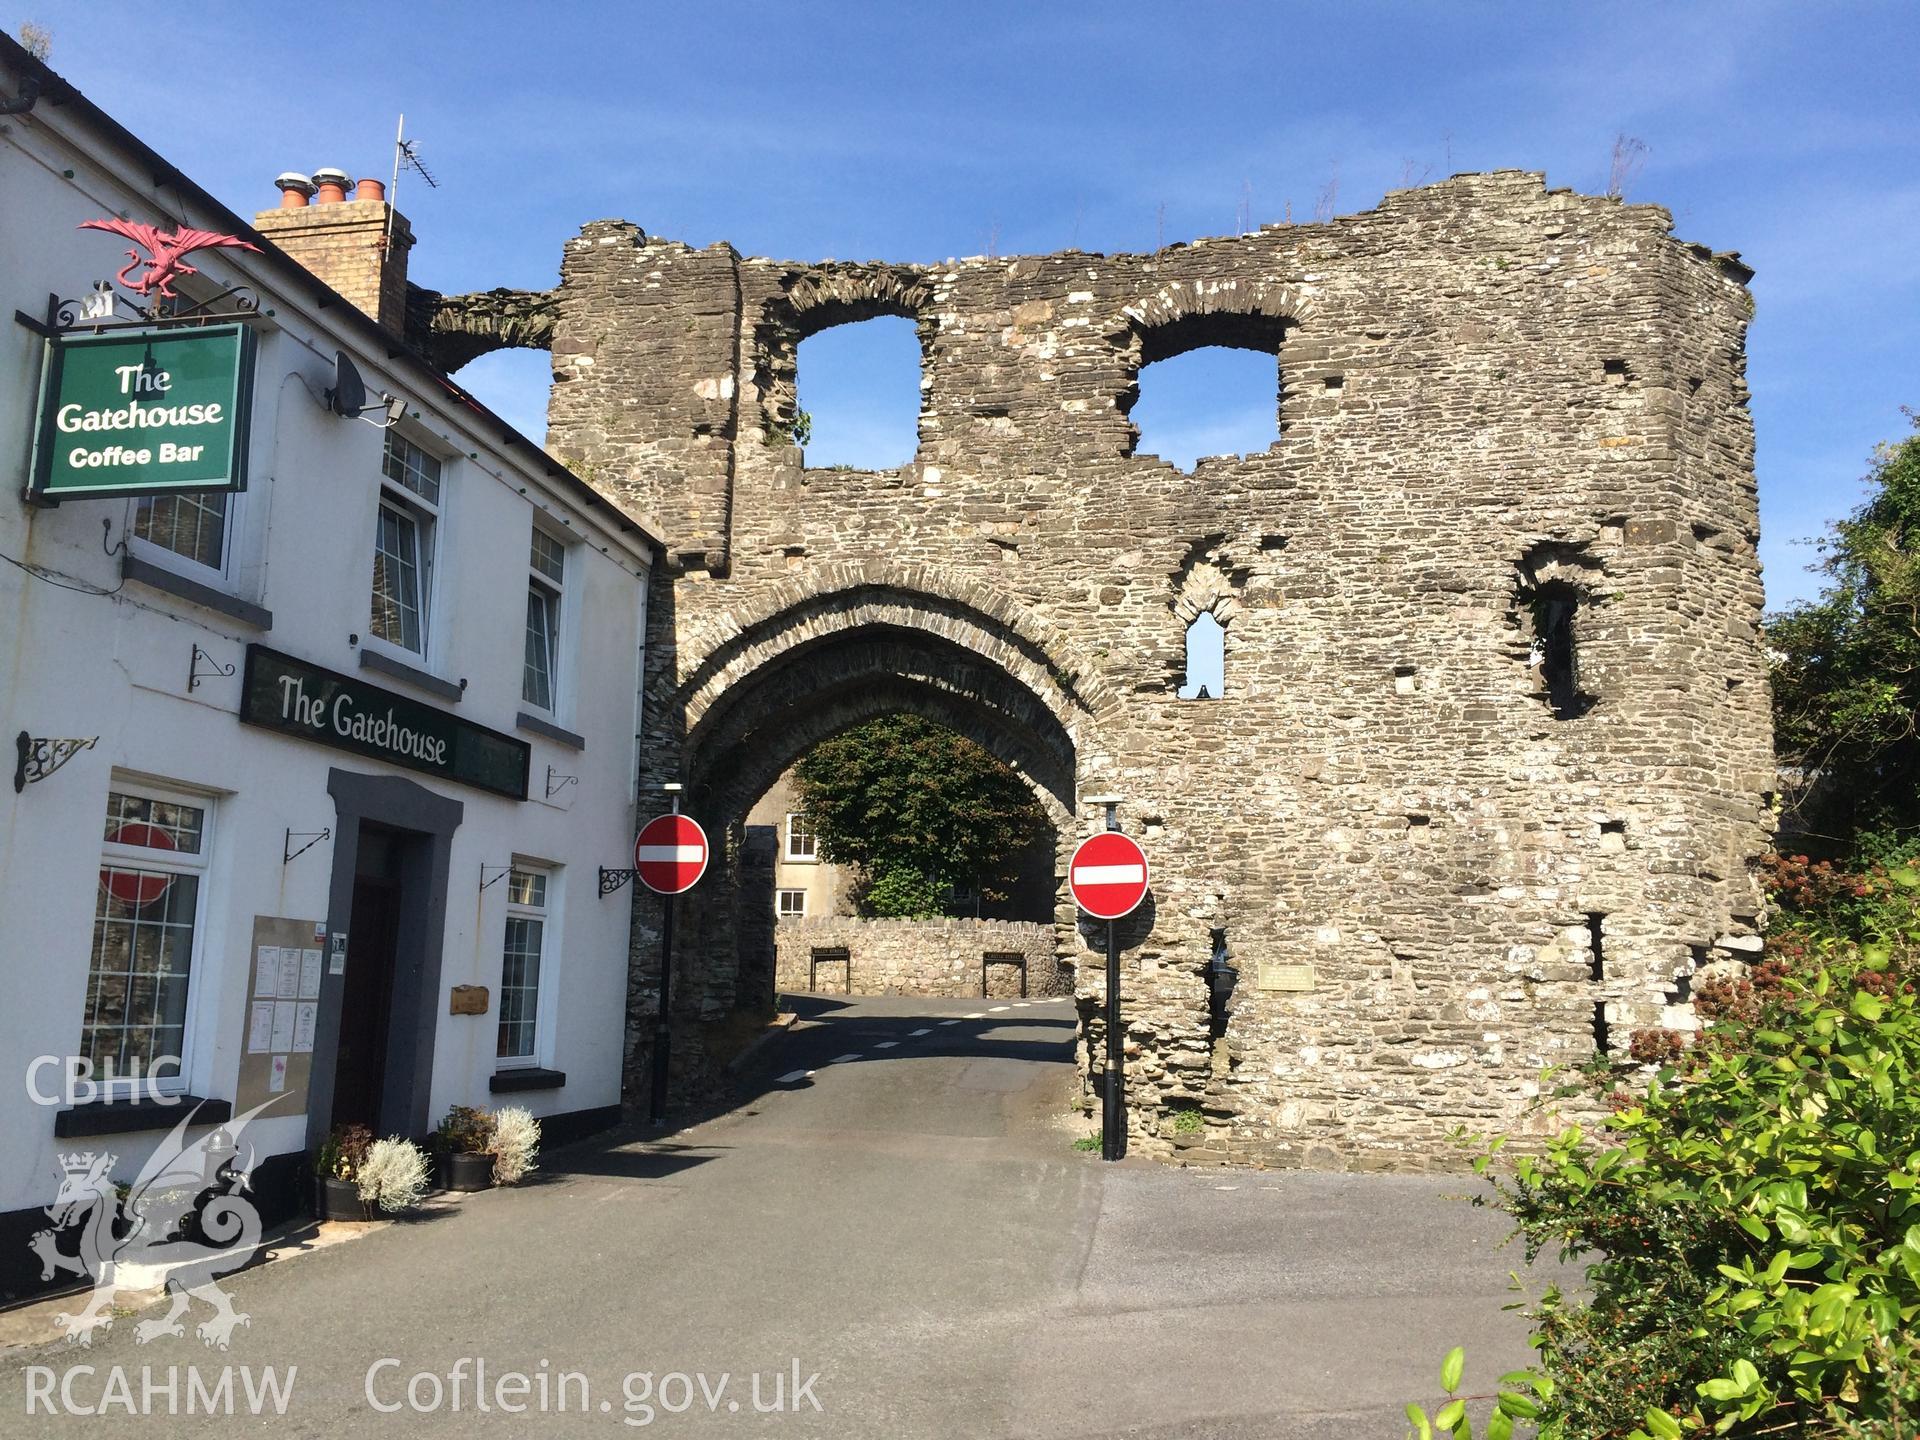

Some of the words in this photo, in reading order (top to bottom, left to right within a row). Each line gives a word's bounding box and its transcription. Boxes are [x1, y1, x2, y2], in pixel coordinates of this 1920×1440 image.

[115, 364, 172, 394] The
[56, 400, 224, 433] Gatehouse
[69, 445, 152, 468] Coffee
[159, 443, 204, 463] Bar
[278, 674, 326, 728] The
[333, 693, 447, 765] Gatehouse
